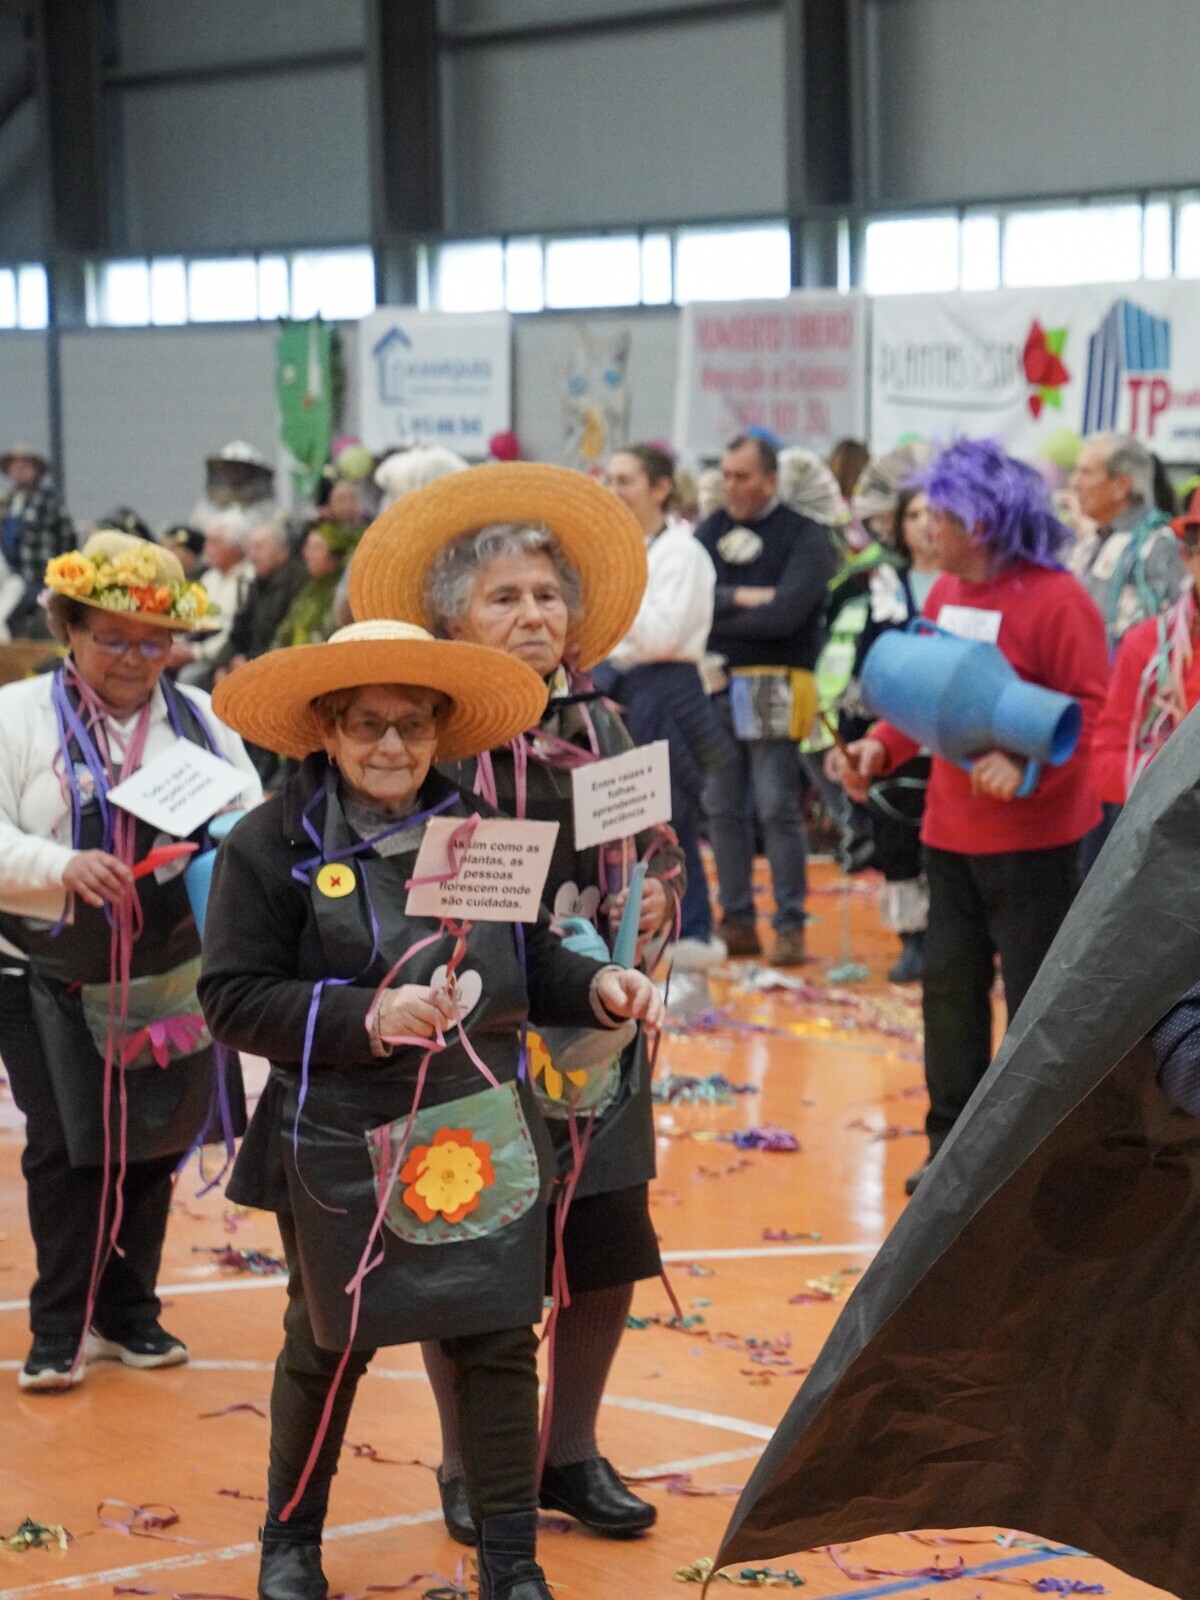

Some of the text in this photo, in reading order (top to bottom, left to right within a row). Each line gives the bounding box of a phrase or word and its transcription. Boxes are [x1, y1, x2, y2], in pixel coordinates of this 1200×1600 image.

[490, 841, 523, 852] como
[526, 843, 540, 854] as
[510, 856, 524, 867] as
[463, 869, 513, 881] pessoas
[439, 881, 532, 896] florescem onde
[441, 895, 522, 909] são cuidadas.
